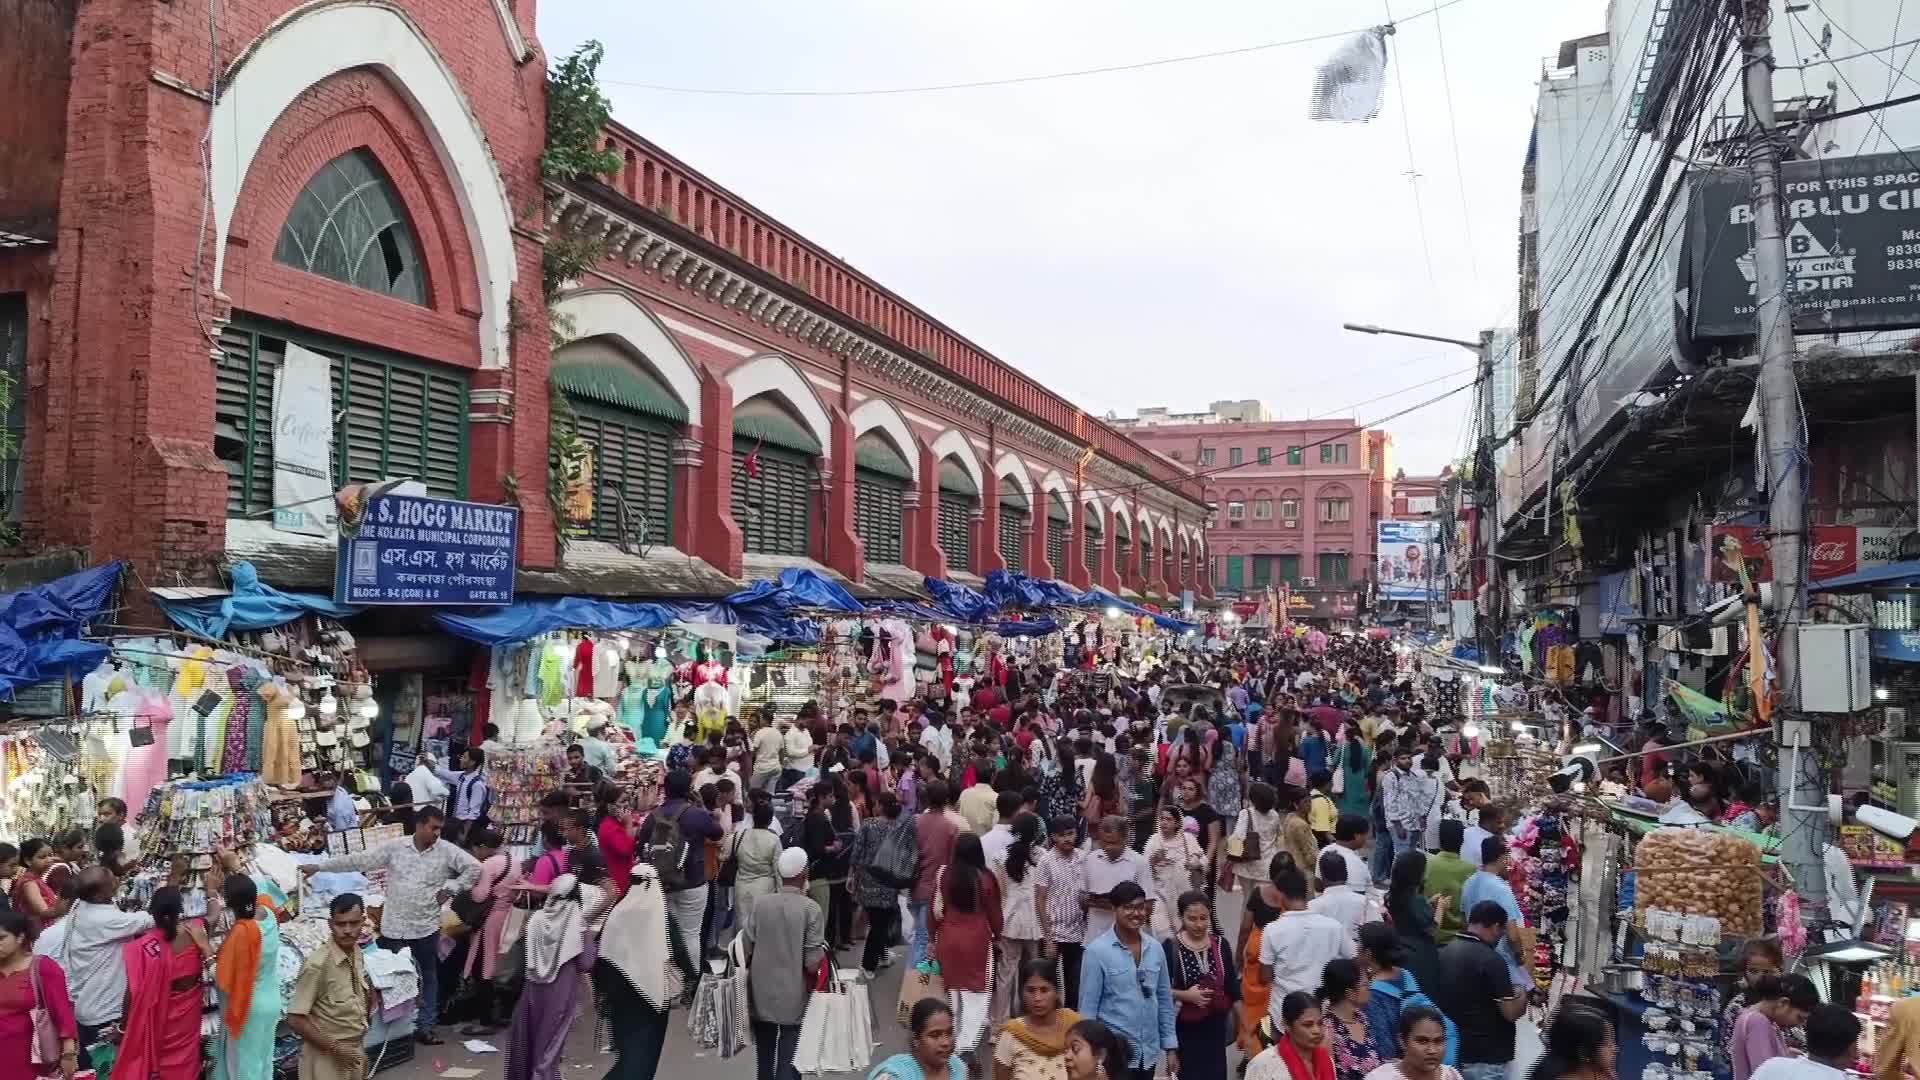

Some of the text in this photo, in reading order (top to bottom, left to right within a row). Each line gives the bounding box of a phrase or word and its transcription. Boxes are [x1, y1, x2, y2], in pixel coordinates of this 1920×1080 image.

[1785, 181, 1821, 194] FOR
[1826, 175, 1868, 190] THIS
[1730, 193, 1869, 225] BBLU
[397, 500, 447, 528] HOGG
[450, 505, 513, 534] MARKET
[377, 526, 416, 541] KOLKATA
[417, 529, 461, 544] MUNICIPAL
[463, 533, 511, 548] CORPORATION
[352, 587, 381, 598] BLOCK
[469, 590, 487, 600] GATE
